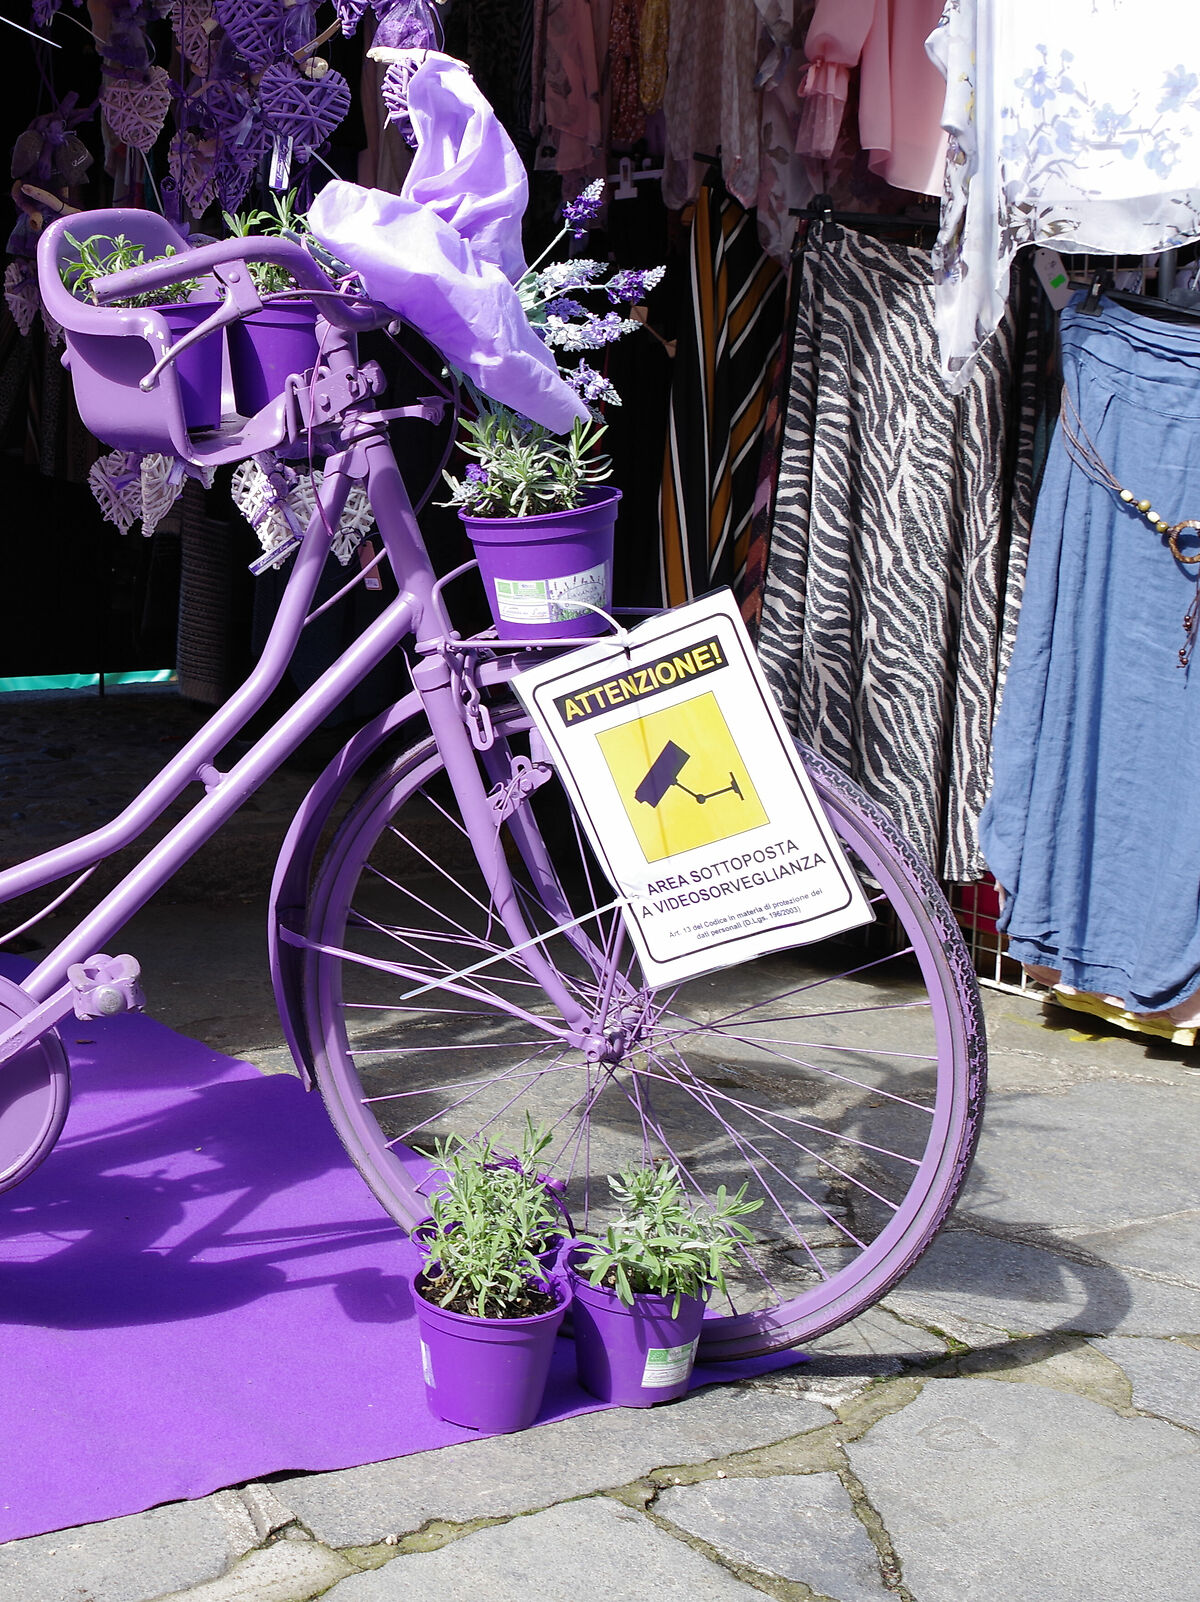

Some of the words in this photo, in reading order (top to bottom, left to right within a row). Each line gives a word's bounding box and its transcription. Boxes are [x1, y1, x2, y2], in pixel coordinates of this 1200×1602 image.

[564, 642, 724, 722] ATTENZIONE!
[641, 905, 654, 919] A
[652, 852, 827, 914] VIDEOSORVEGLIANZA
[646, 873, 690, 896] AREA
[689, 838, 800, 883] SOTTOPOSTA
[683, 925, 692, 934] 13
[703, 915, 728, 928] Codice
[736, 906, 764, 920] materia
[764, 901, 772, 911] di
[772, 893, 809, 911] protezione
[696, 930, 710, 941] dati
[710, 920, 743, 938] personali
